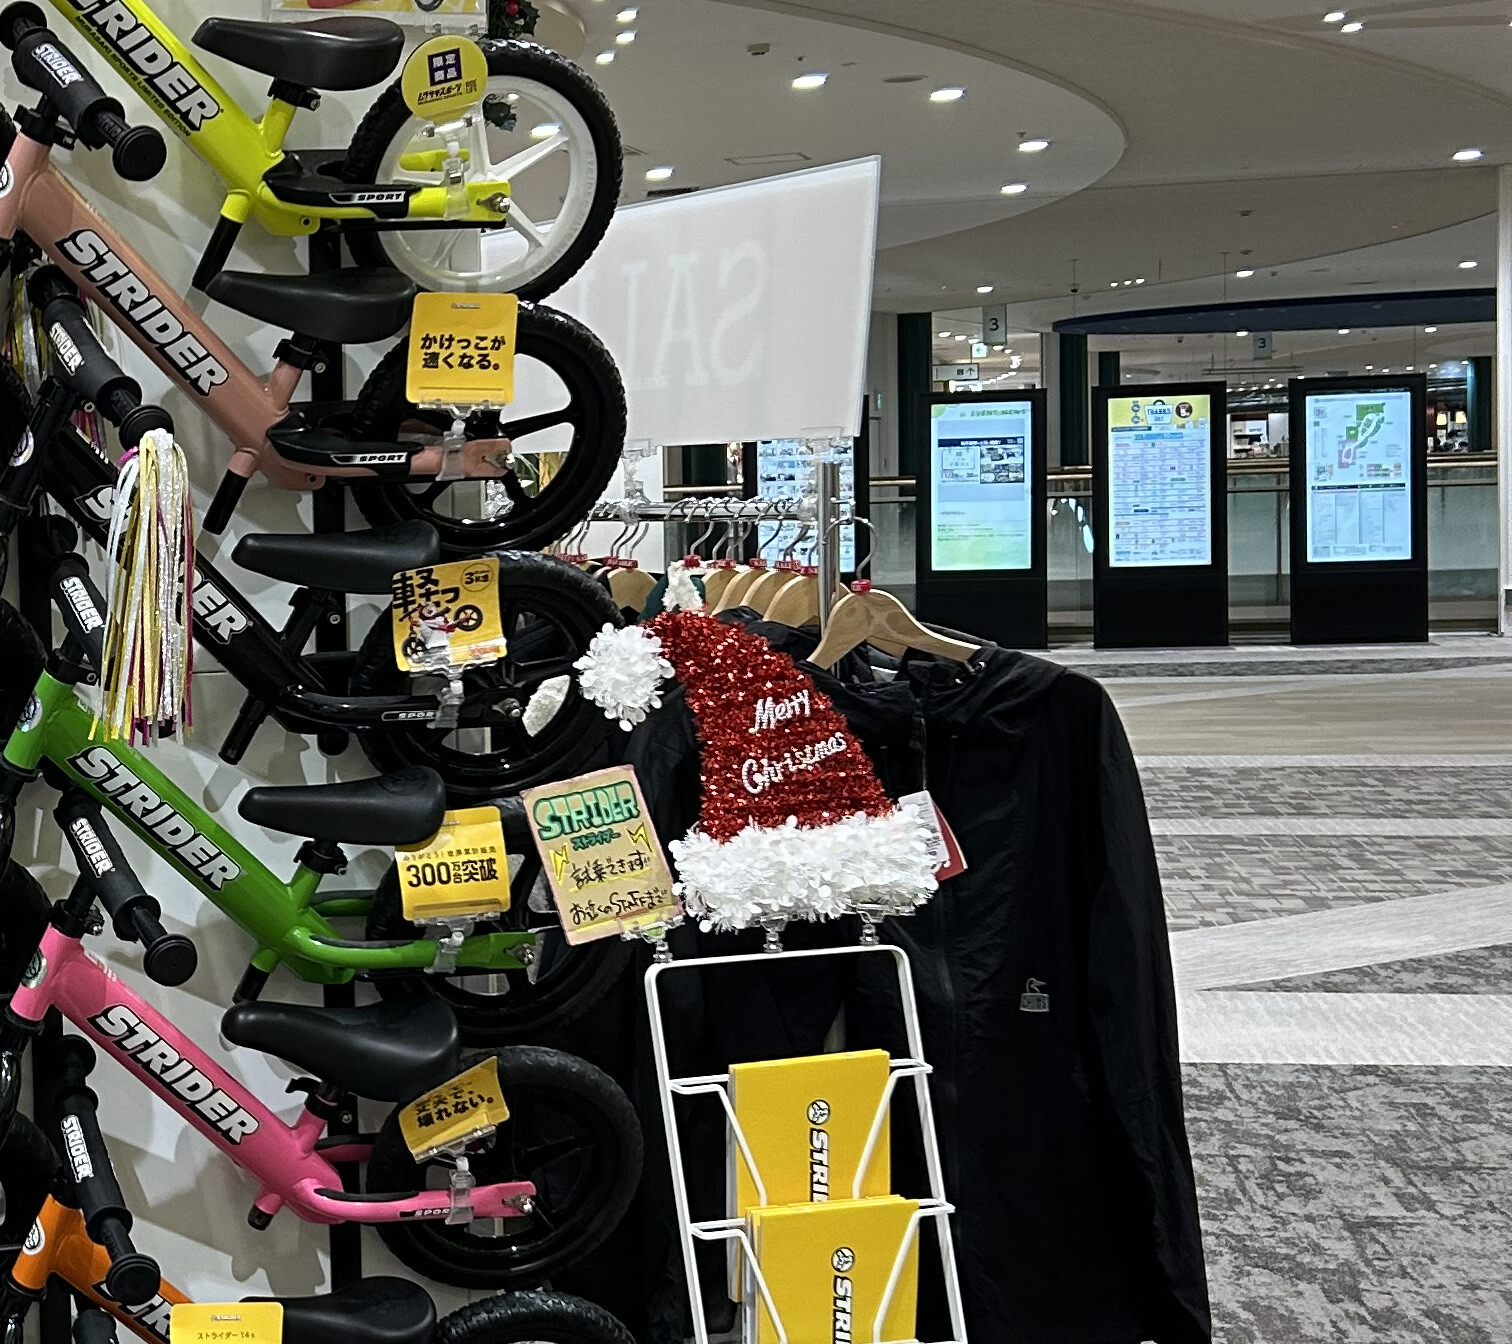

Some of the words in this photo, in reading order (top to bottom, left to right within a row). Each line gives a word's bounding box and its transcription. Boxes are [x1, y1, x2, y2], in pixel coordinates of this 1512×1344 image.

[30, 42, 84, 89] STRIDER
[75, 15, 113, 56] MURASAKI
[137, 78, 165, 110] LIMITED
[357, 193, 403, 201] SPORT
[55, 228, 229, 397] STRIDER
[988, 318, 1000, 332] 3
[48, 321, 86, 377] STRIDER
[420, 333, 506, 351] かけっこが
[1257, 337, 1267, 350] 3
[359, 454, 404, 462] SPORT
[60, 576, 105, 634] STRIDER
[397, 711, 436, 719] SPOR
[749, 689, 811, 733] Merry
[741, 731, 847, 794] Christmas
[68, 747, 243, 892] STRIDER
[533, 780, 640, 841] STRIDER
[69, 817, 115, 879] STRIDER
[570, 828, 622, 851] ストライダー
[87, 1005, 261, 1145] STRIDER
[60, 1114, 94, 1184] STRIDER
